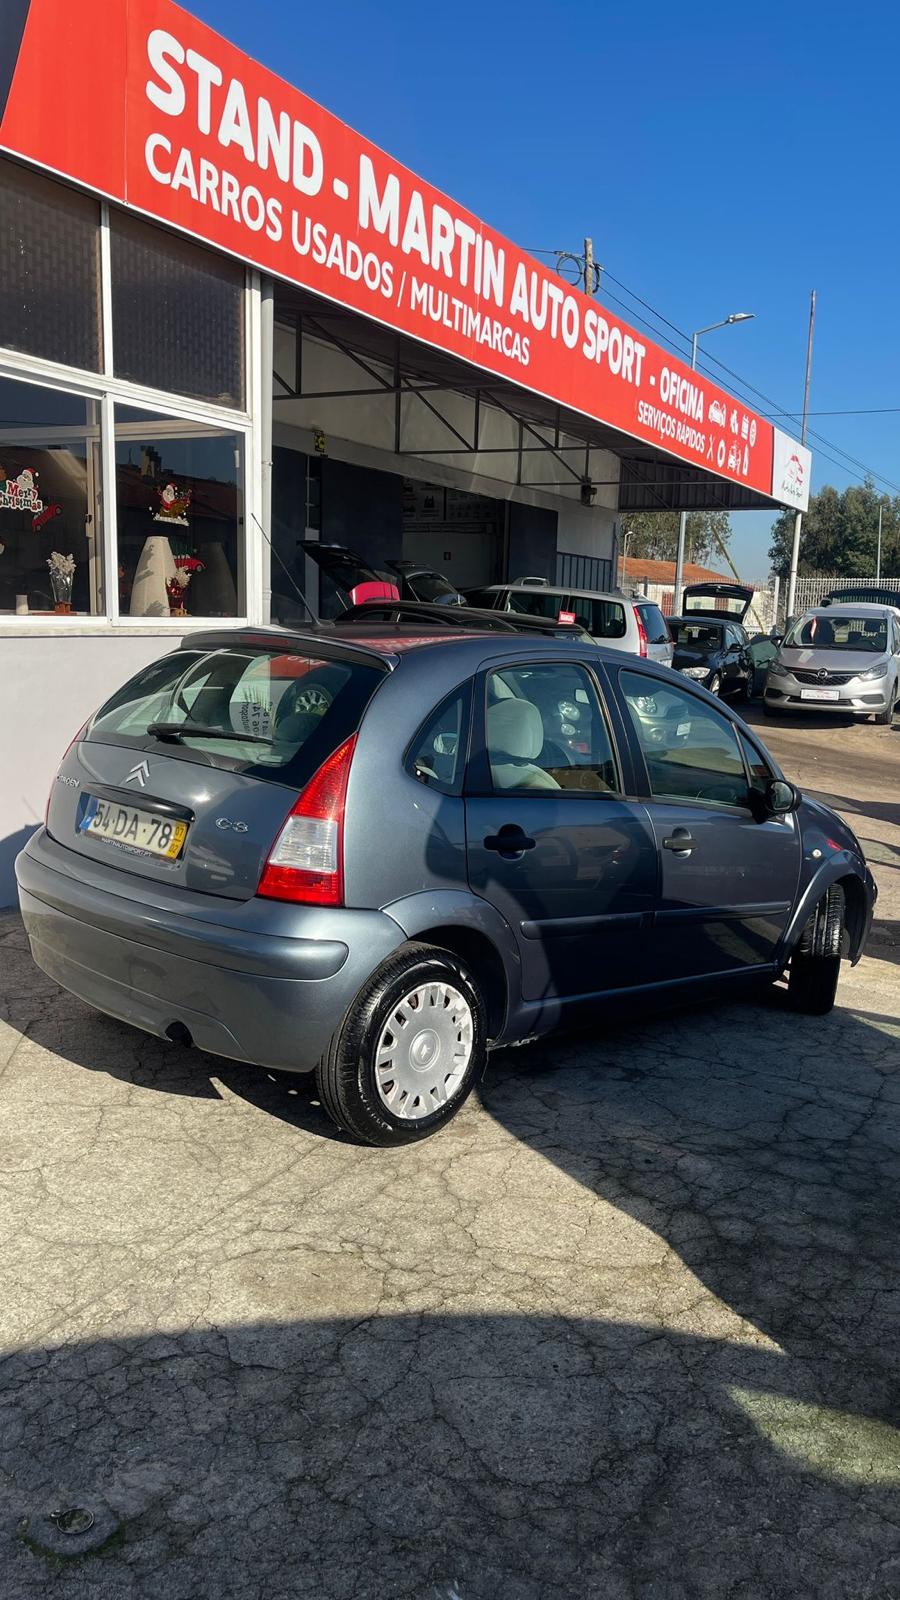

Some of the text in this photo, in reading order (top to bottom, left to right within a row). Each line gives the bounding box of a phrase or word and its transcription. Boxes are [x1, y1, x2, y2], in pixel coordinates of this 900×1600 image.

[144, 29, 324, 197] STAND
[332, 177, 349, 201] -
[358, 153, 506, 308] MARTIN
[509, 262, 580, 349] AUTO
[582, 308, 647, 388] SPORT
[660, 366, 704, 424] OFICINA
[144, 132, 530, 366] CARROS USADOS / MULTIMARCAS
[637, 400, 706, 454] SERVIÇOS RÁPIDOS
[7, 480, 37, 502] Merry
[215, 817, 249, 832] C3
